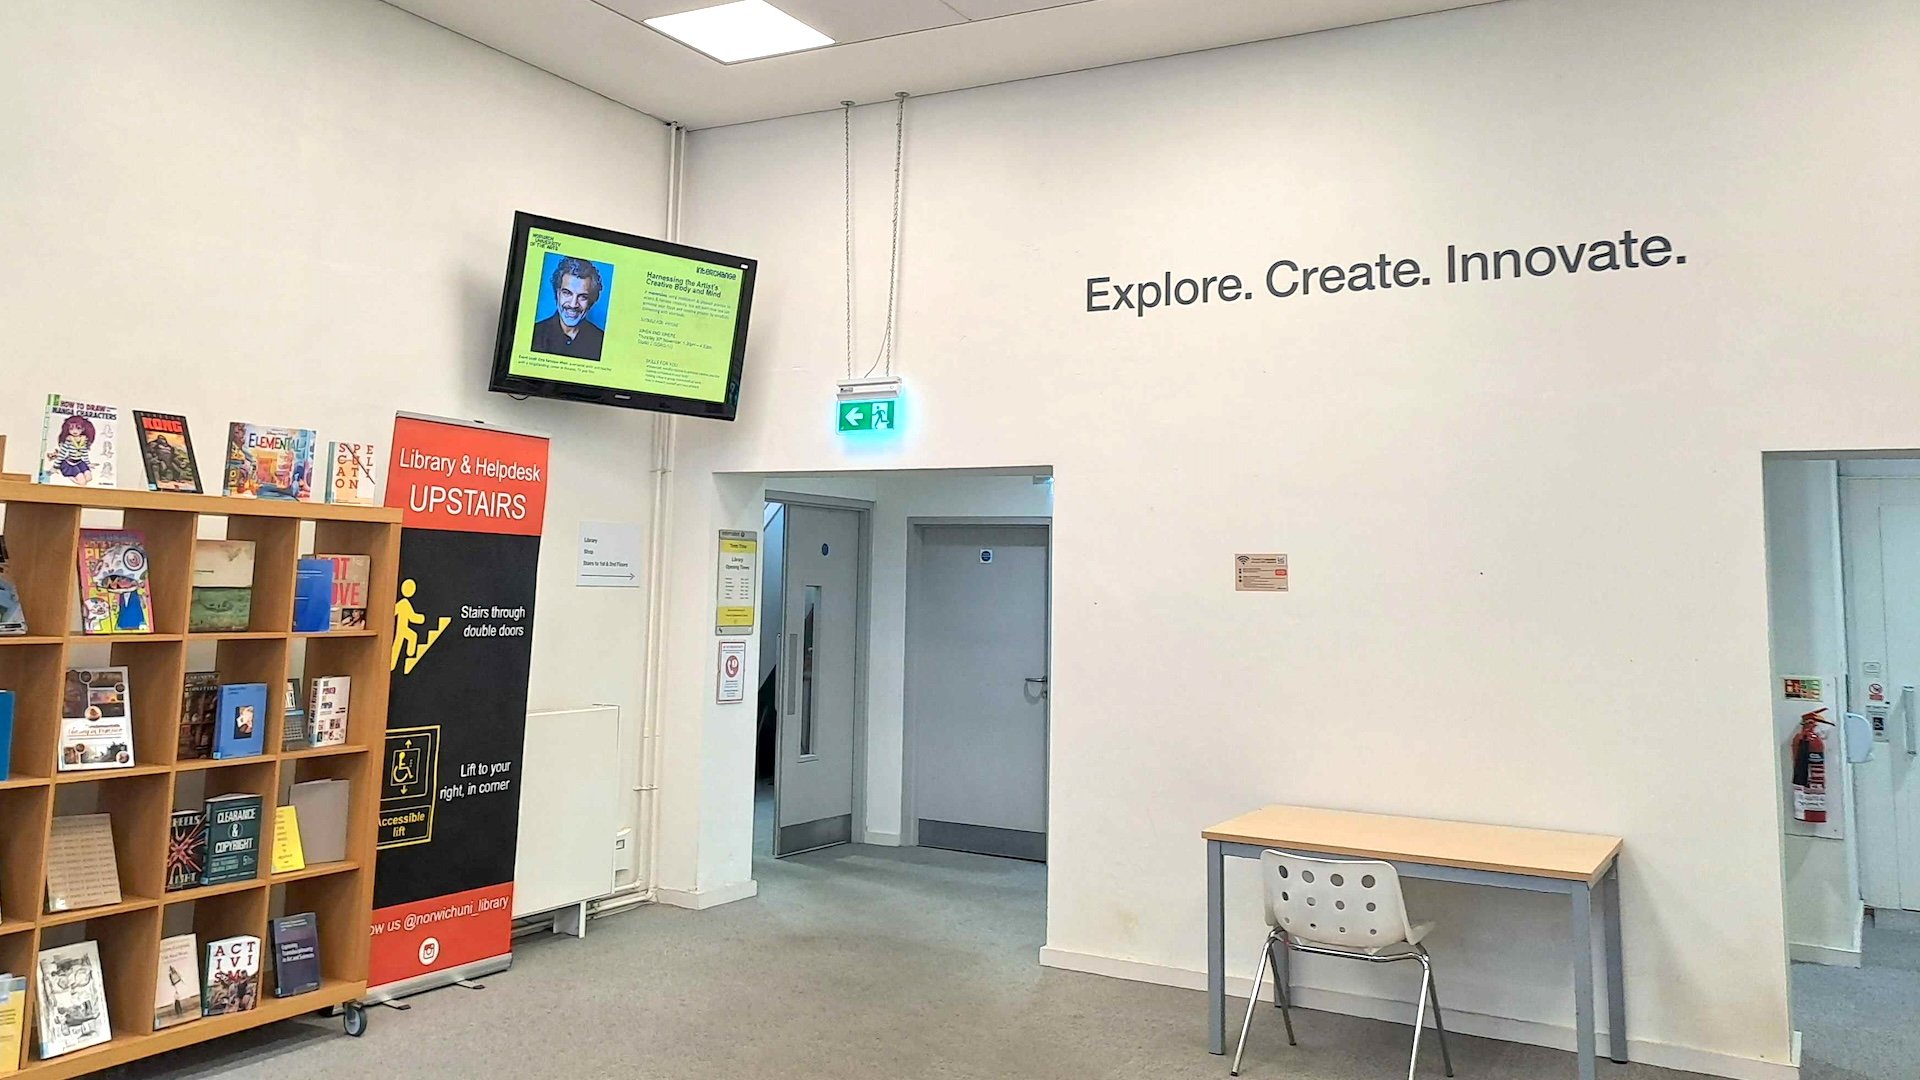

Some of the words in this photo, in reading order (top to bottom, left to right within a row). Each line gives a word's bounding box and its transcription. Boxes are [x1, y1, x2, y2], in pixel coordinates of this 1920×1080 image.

[646, 271, 684, 286] Harnessing
[685, 278, 696, 286] the
[696, 280, 719, 291] Artist's
[1086, 271, 1253, 318] Explore.
[1266, 253, 1432, 299] Create.
[1447, 229, 1688, 284] Innovate.
[646, 278, 672, 289] Creative
[674, 283, 692, 294] Body
[706, 289, 722, 298] Mind
[52, 407, 74, 416] MANGA
[76, 410, 117, 420] CHARACTERS
[60, 400, 75, 408] HOW
[76, 402, 85, 410] TO
[86, 404, 106, 412] DRAW
[142, 417, 184, 433] KONG
[249, 433, 304, 452] ELEMENTAL
[400, 448, 456, 478] Library
[460, 454, 471, 474] &
[476, 457, 540, 482] Helpdesk
[410, 484, 526, 520] UPSTAIRS
[332, 583, 361, 606] OVE
[461, 605, 490, 619] Stairs
[491, 606, 526, 622] through
[464, 624, 497, 637] double
[498, 624, 524, 636] doors
[460, 762, 476, 778] Lift
[478, 763, 488, 776] to
[490, 762, 512, 777] your
[440, 784, 464, 802] right,
[468, 782, 477, 796] in
[479, 780, 510, 794] corner
[217, 808, 256, 824] CLEARANCE
[231, 823, 239, 838] &
[392, 826, 406, 838] lift
[215, 838, 254, 854] COPYRIGHT
[388, 920, 402, 932] us
[404, 896, 510, 931] @norwichuni_library
